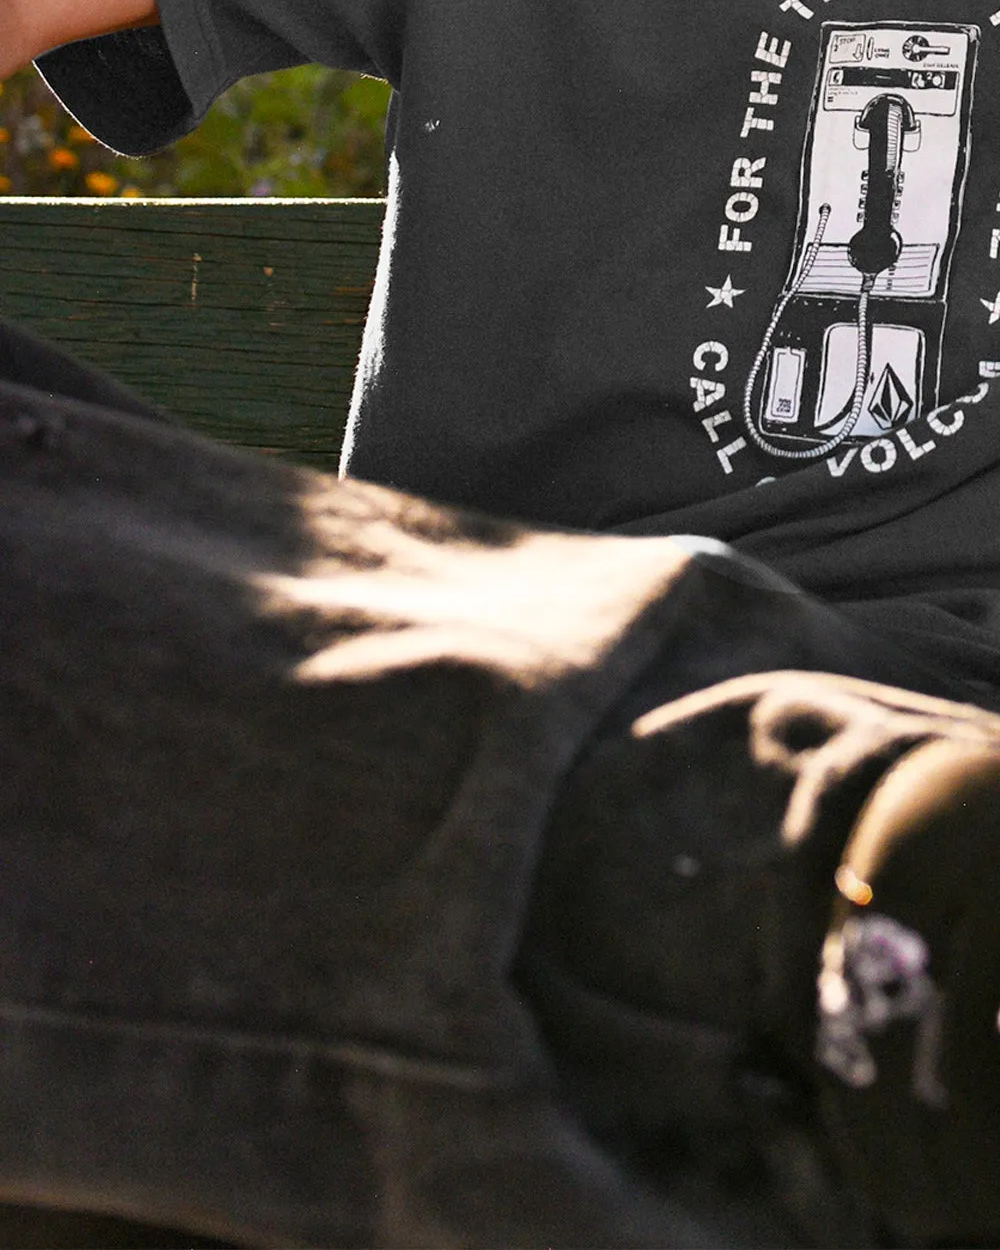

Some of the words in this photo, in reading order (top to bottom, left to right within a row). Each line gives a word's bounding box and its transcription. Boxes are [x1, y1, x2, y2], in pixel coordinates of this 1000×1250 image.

[740, 31, 792, 138] THE
[717, 156, 767, 252] FOR
[689, 340, 748, 475] CALL
